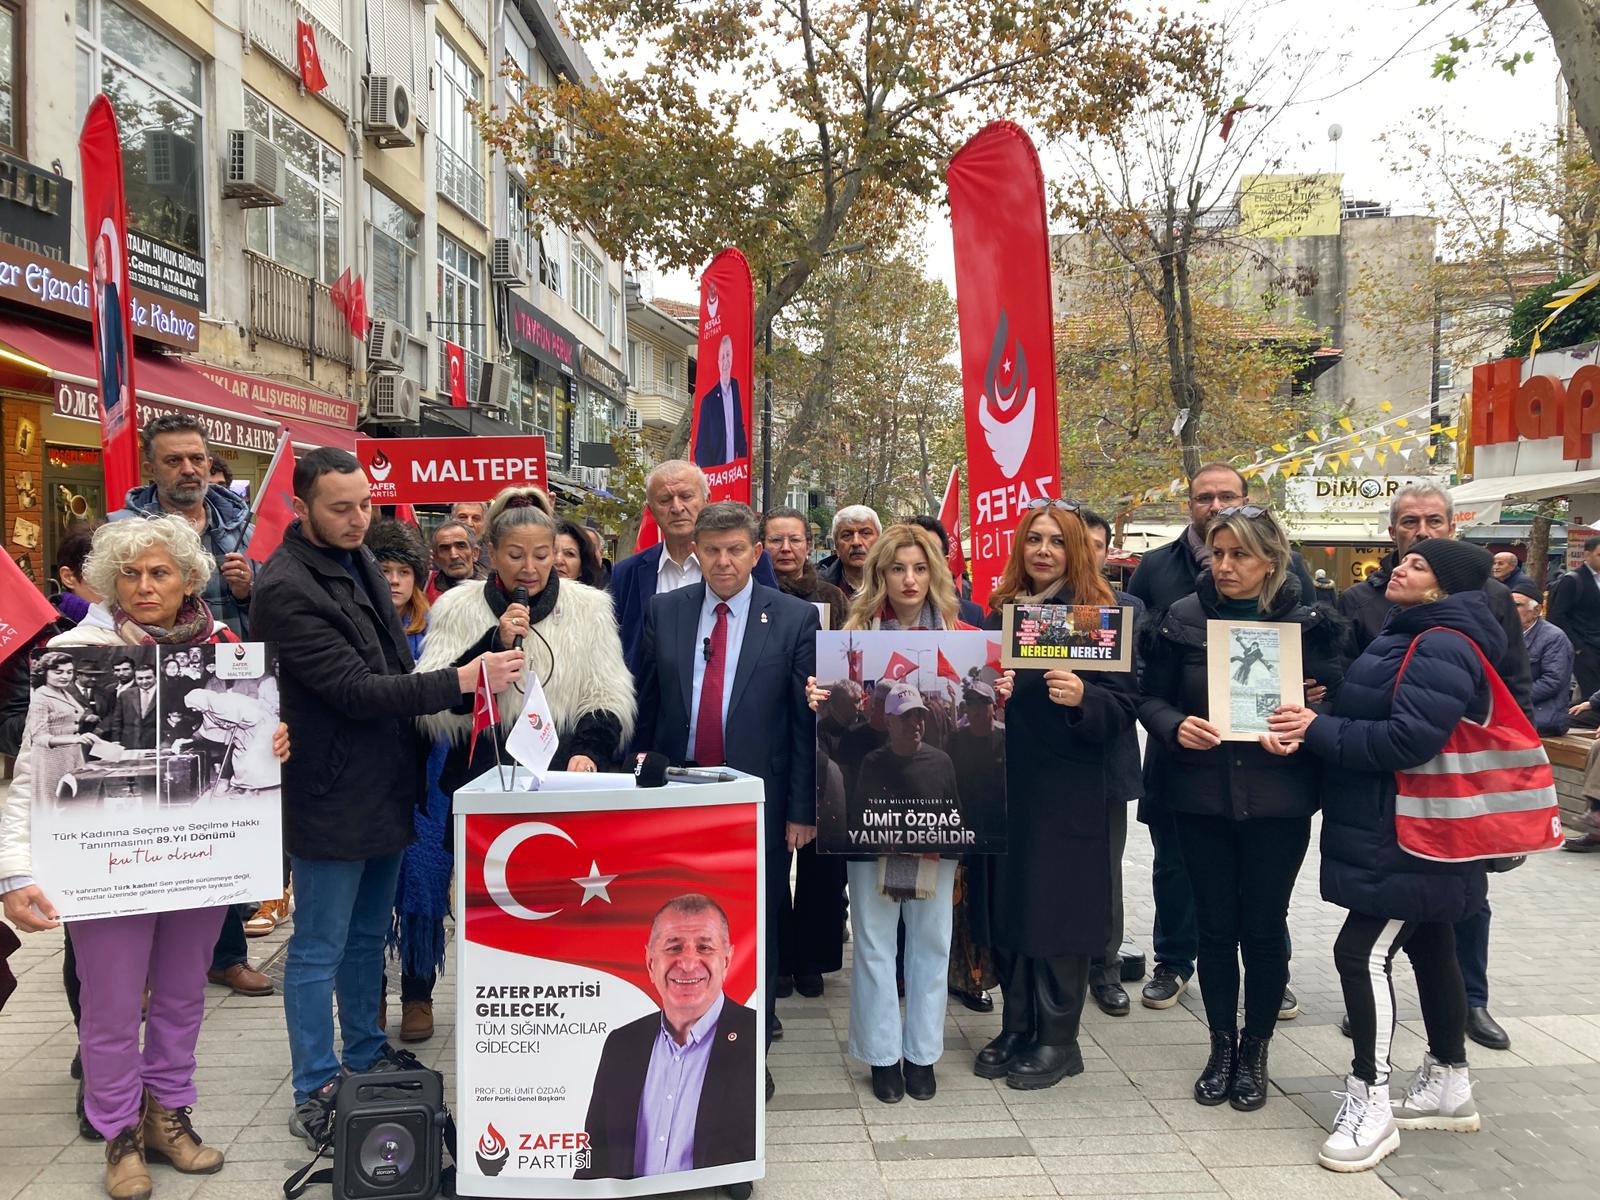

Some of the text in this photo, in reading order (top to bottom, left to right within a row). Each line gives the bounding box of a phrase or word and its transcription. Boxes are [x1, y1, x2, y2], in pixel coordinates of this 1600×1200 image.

[152, 243, 178, 267] HUKUK
[178, 253, 204, 277] BÜROSU
[162, 267, 197, 289] ATALAY
[25, 263, 89, 308] Efendi
[151, 303, 196, 340] Kahve
[252, 384, 307, 414] ALIŞVERİŞ
[309, 398, 350, 421] MERKEZİ
[236, 421, 275, 451] KAHVE
[411, 457, 539, 483] MALTEPE
[1020, 645, 1112, 659] NEREDEN NEREYE
[863, 808, 961, 827] ÜMİT ÖZDAĞ
[52, 832, 78, 841] Türk
[81, 829, 129, 840] Kadınına
[132, 826, 170, 836] Seçme
[188, 821, 228, 831] Seçilme
[232, 818, 260, 828] Hakkı
[848, 826, 976, 845] YALNIZ DEĞİLDİR
[80, 830, 236, 850] Tanınmasının 89.Yıl Dönümü
[108, 843, 212, 874] kutlu olsun!
[76, 885, 112, 895] kahraman
[114, 884, 131, 892] Türk
[174, 878, 195, 887] yerde
[195, 874, 232, 884] sürünmeye
[76, 894, 105, 902] omuzlar
[107, 890, 138, 899] üzerinde
[139, 888, 165, 897] göklere
[166, 884, 207, 894] yükselmeye
[475, 981, 601, 999] ZAFER PARTİSİ
[475, 1002, 565, 1019] GELECEK,
[475, 1021, 607, 1036] TÜM SIĞINMACILAR
[475, 1038, 540, 1054] GİDECEK!
[474, 1085, 566, 1095] PROF. DR. ÜMİT ÖZDAĞ
[476, 1095, 565, 1103] Zafer Partisi Genel Başkanı
[518, 1132, 591, 1150] ZAFER
[518, 1150, 591, 1170] PARTİSİ
